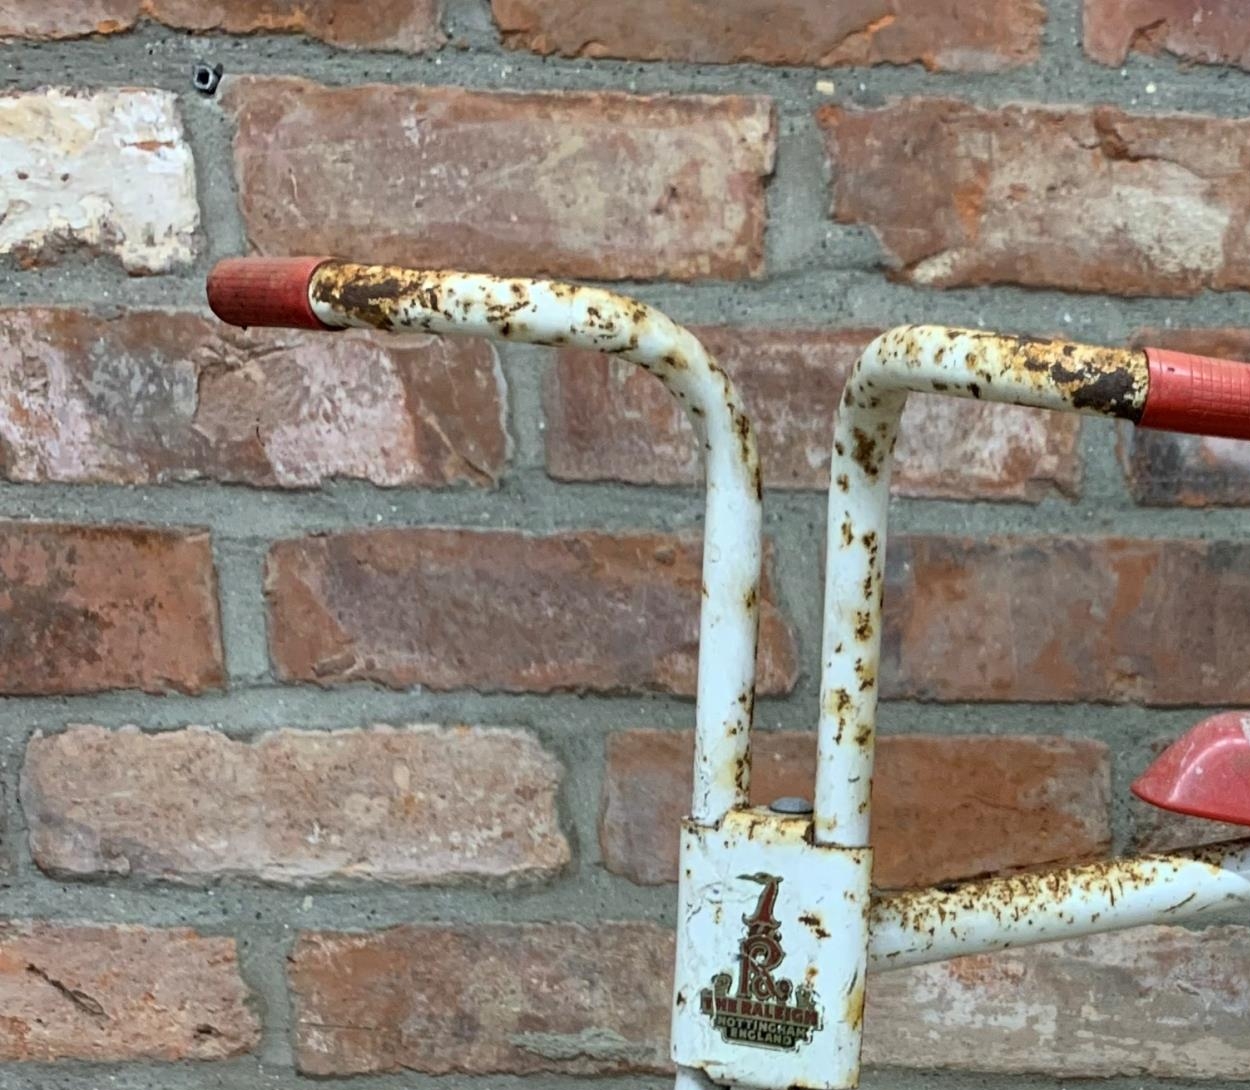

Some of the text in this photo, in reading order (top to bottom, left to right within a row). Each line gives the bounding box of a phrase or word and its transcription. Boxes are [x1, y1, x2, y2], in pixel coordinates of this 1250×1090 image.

[704, 997, 818, 1025] THE RALEIGH
[718, 1016, 806, 1038] NOTTINGHAM
[730, 1027, 793, 1045] ENGLAND
